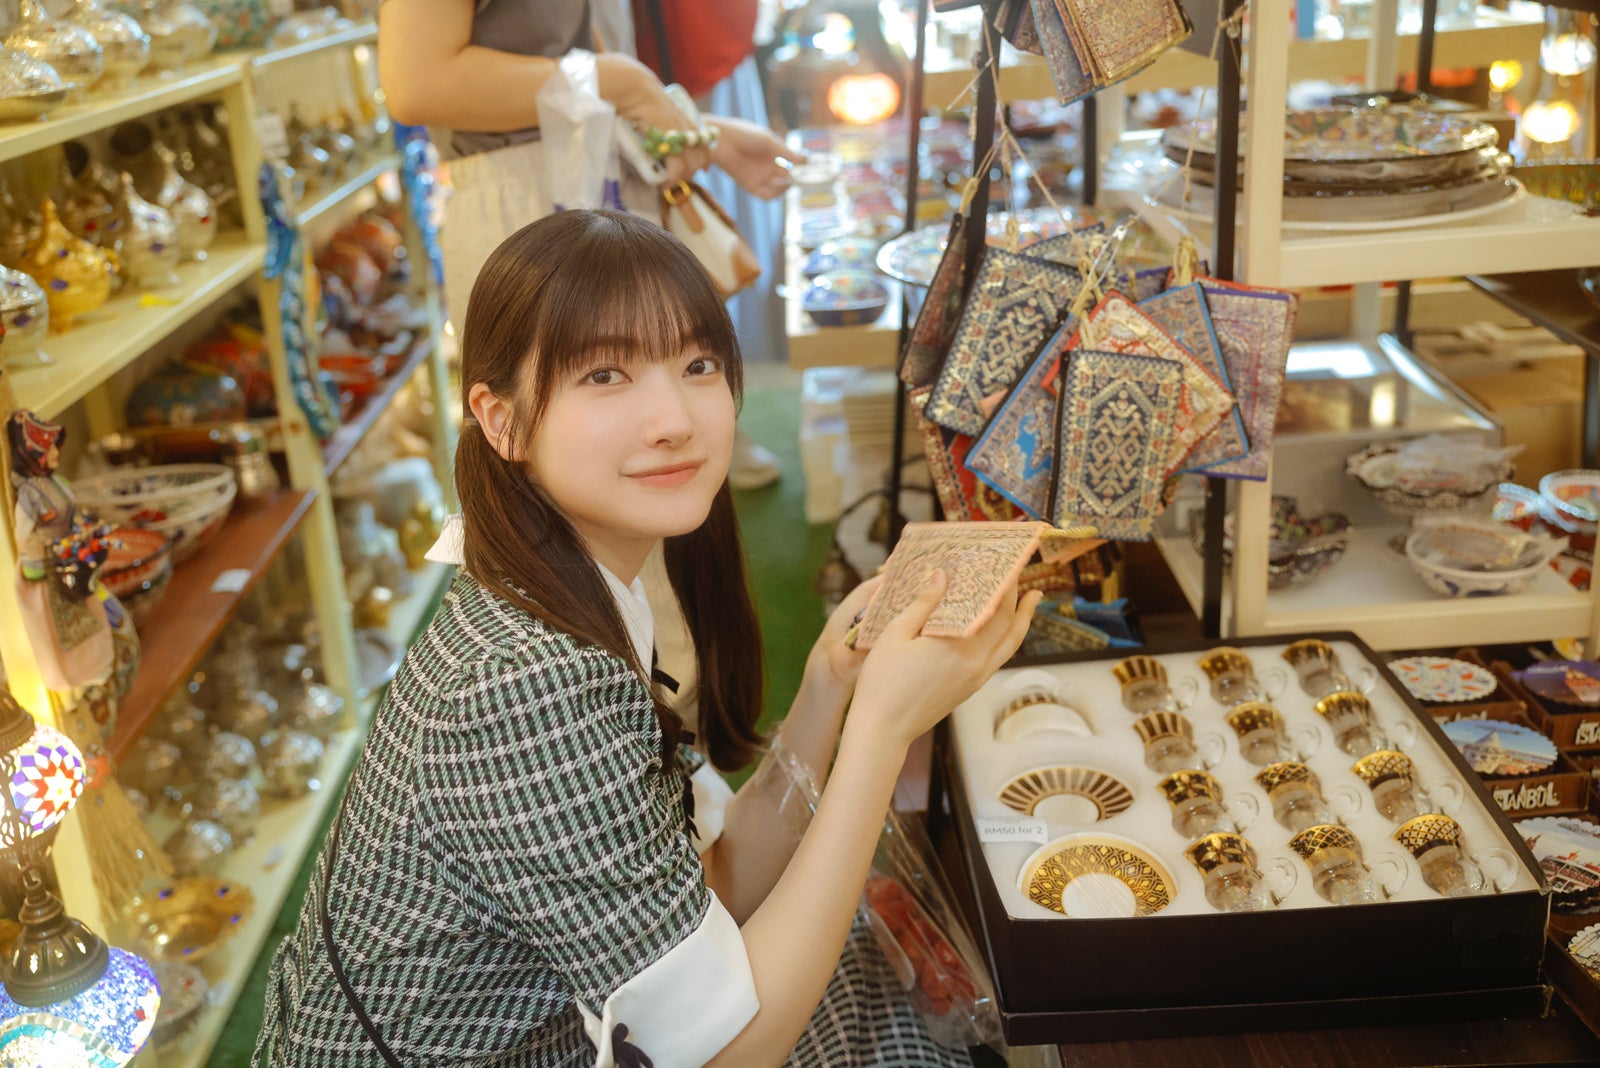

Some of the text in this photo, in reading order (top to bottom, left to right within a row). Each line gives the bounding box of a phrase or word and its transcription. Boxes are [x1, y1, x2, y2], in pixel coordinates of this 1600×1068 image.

[1493, 782, 1560, 811] STANBUL
[984, 826, 1044, 835] RM50 for 2
